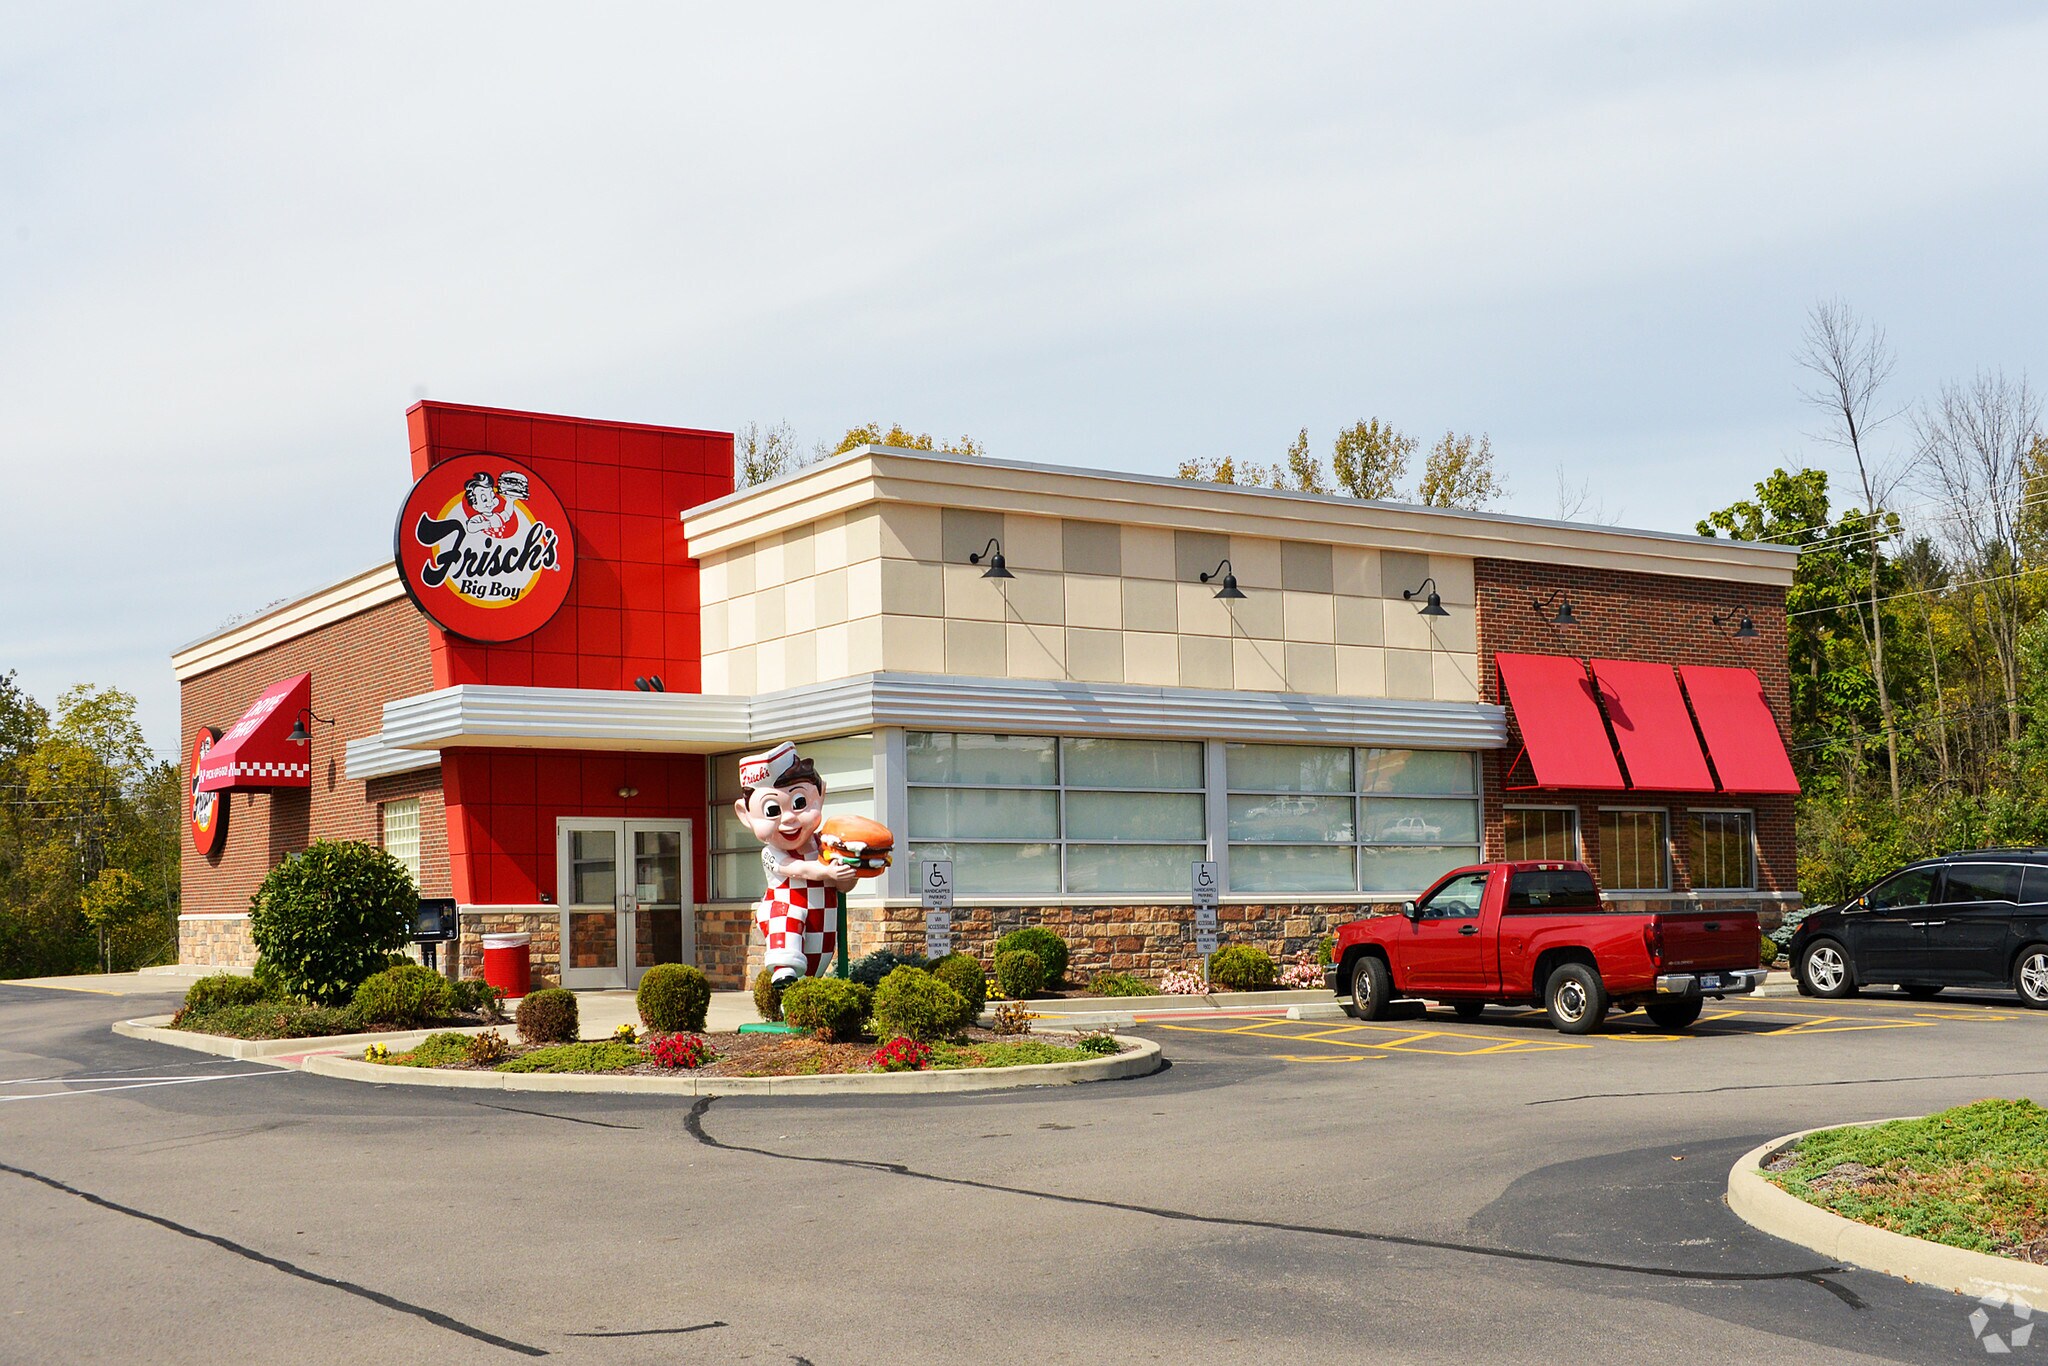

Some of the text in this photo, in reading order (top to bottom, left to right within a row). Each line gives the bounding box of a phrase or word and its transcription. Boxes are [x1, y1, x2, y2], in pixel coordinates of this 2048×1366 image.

[416, 512, 557, 586] Frisch's
[459, 579, 521, 601] Big Boy
[243, 692, 287, 719] DRIVE
[225, 716, 264, 741] THRU
[741, 766, 770, 786] Frisch's
[763, 851, 776, 864] BIG
